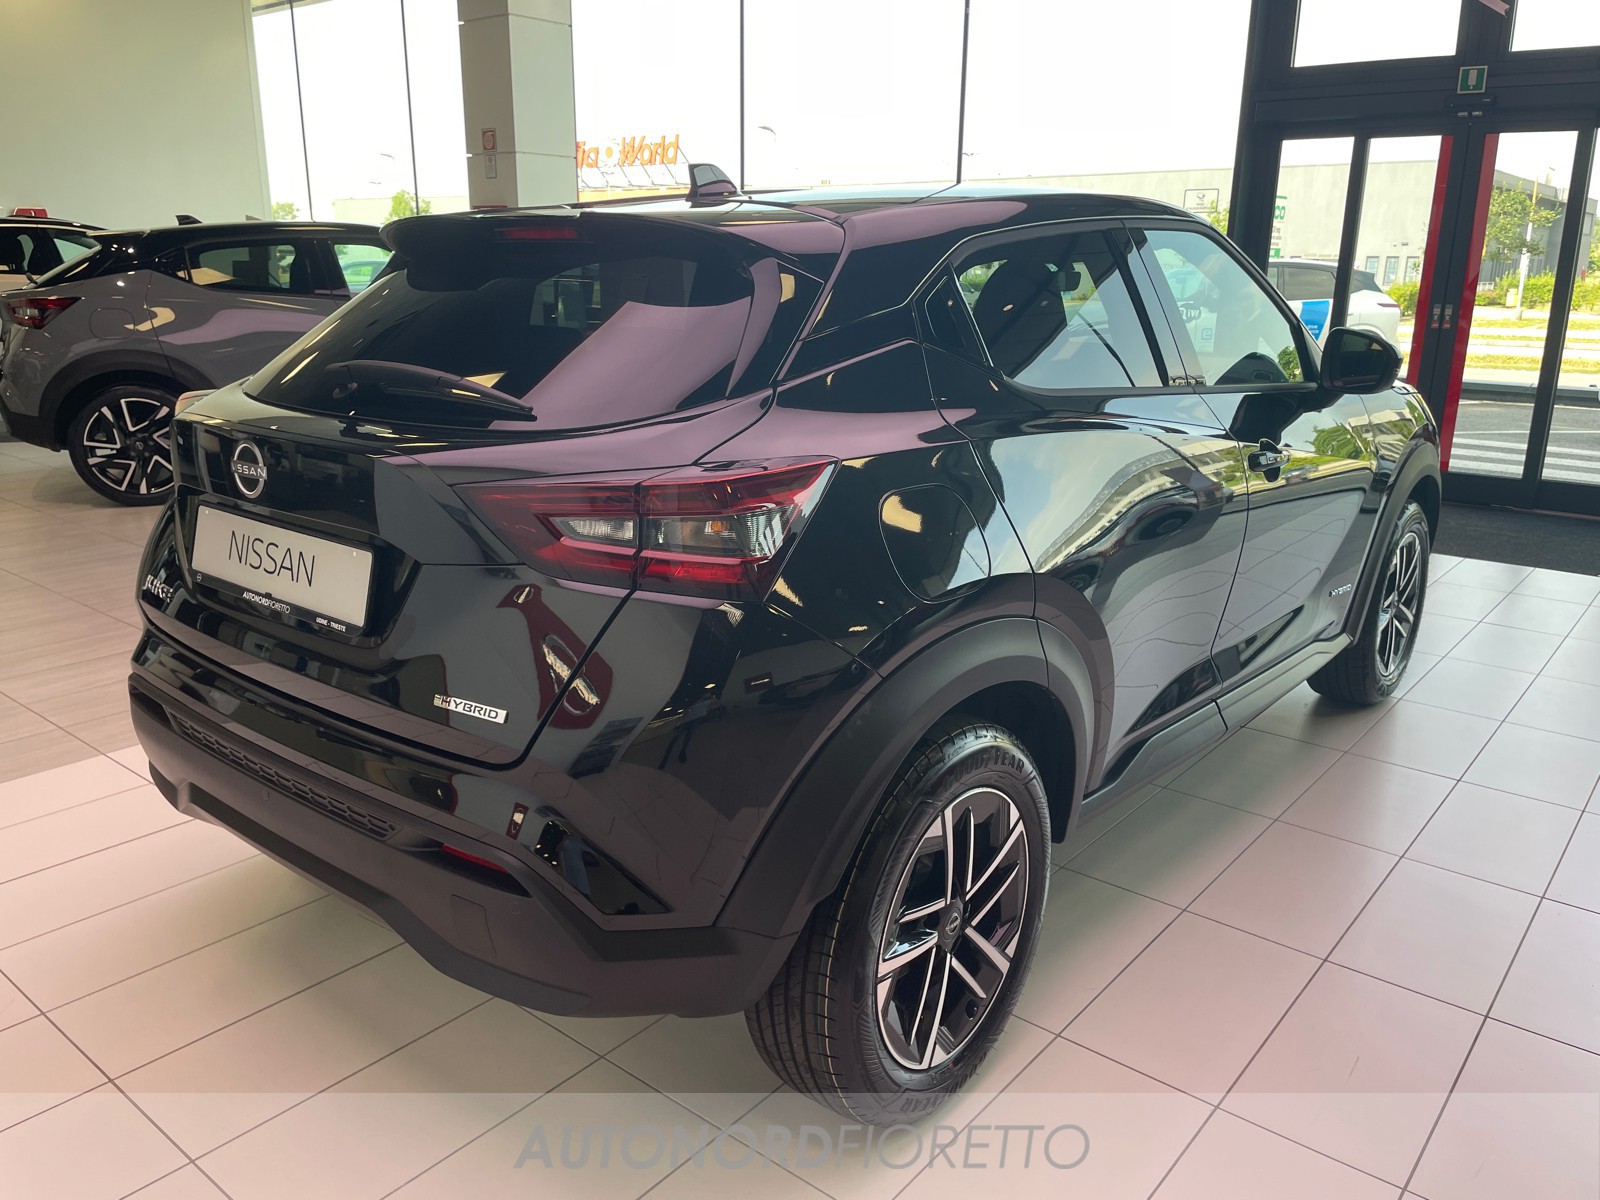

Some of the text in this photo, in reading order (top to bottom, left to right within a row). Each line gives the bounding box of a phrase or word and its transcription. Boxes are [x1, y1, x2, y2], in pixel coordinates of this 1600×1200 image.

[619, 134, 679, 166] World
[231, 461, 266, 477] SSAN
[228, 530, 315, 587] NISSAN
[242, 591, 291, 614] AUTONORDFIORETTO
[440, 696, 499, 720] HYBRID
